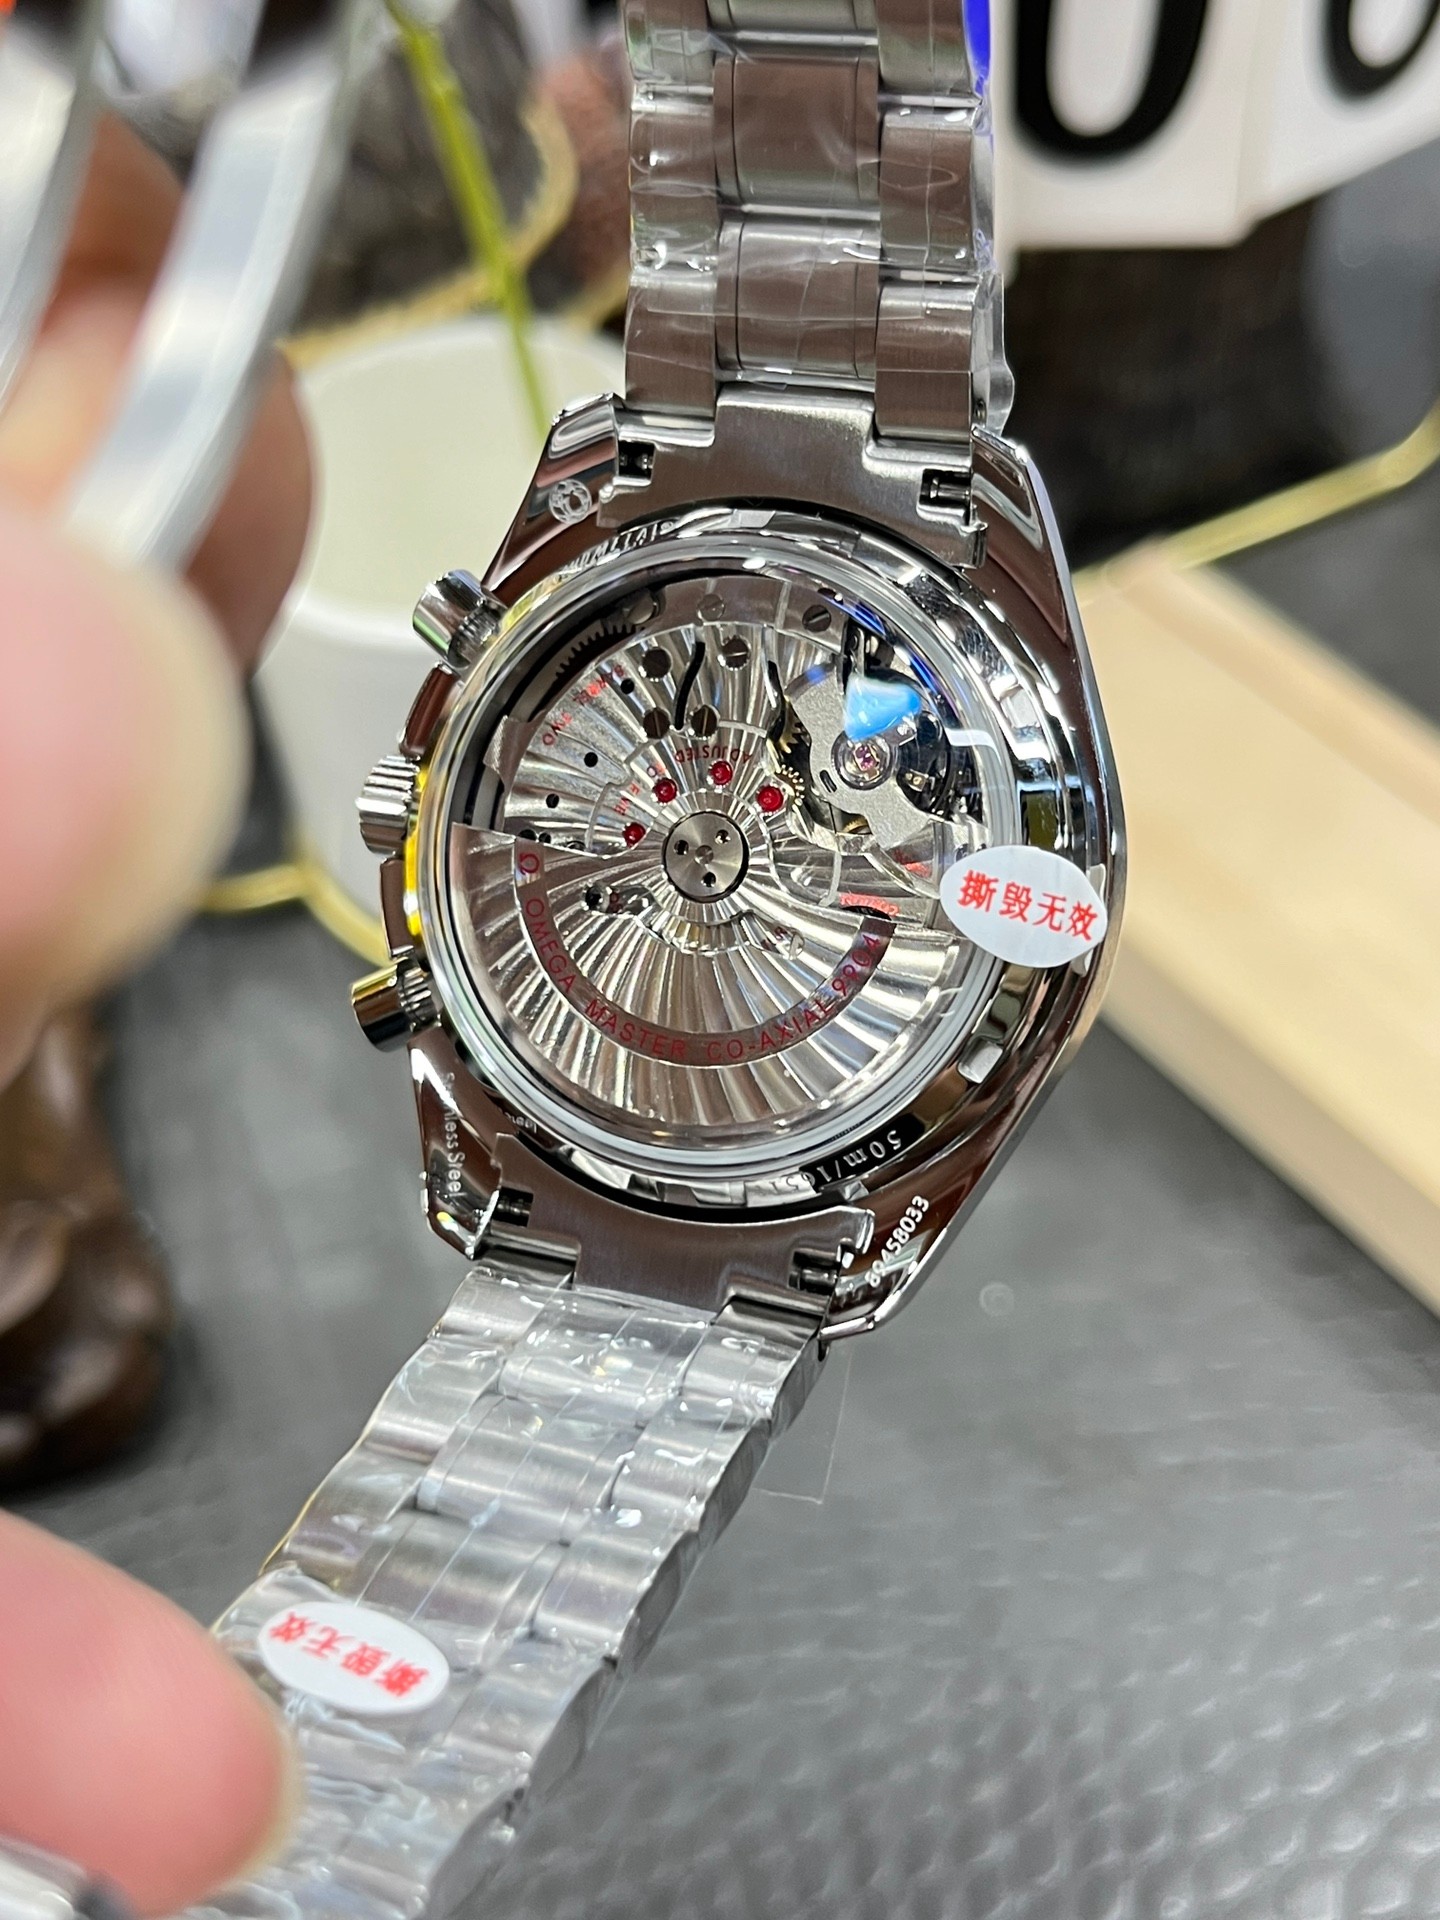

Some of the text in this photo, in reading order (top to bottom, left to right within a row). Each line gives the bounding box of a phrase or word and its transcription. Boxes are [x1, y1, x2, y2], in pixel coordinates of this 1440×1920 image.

[675, 744, 754, 763] ADJUSTED
[957, 869, 1099, 942] 撕毁无效
[525, 898, 577, 992] OMEGA
[585, 999, 687, 1059] MASTER
[447, 1151, 468, 1198] Steel
[269, 1611, 429, 1697] 撕毁无效
